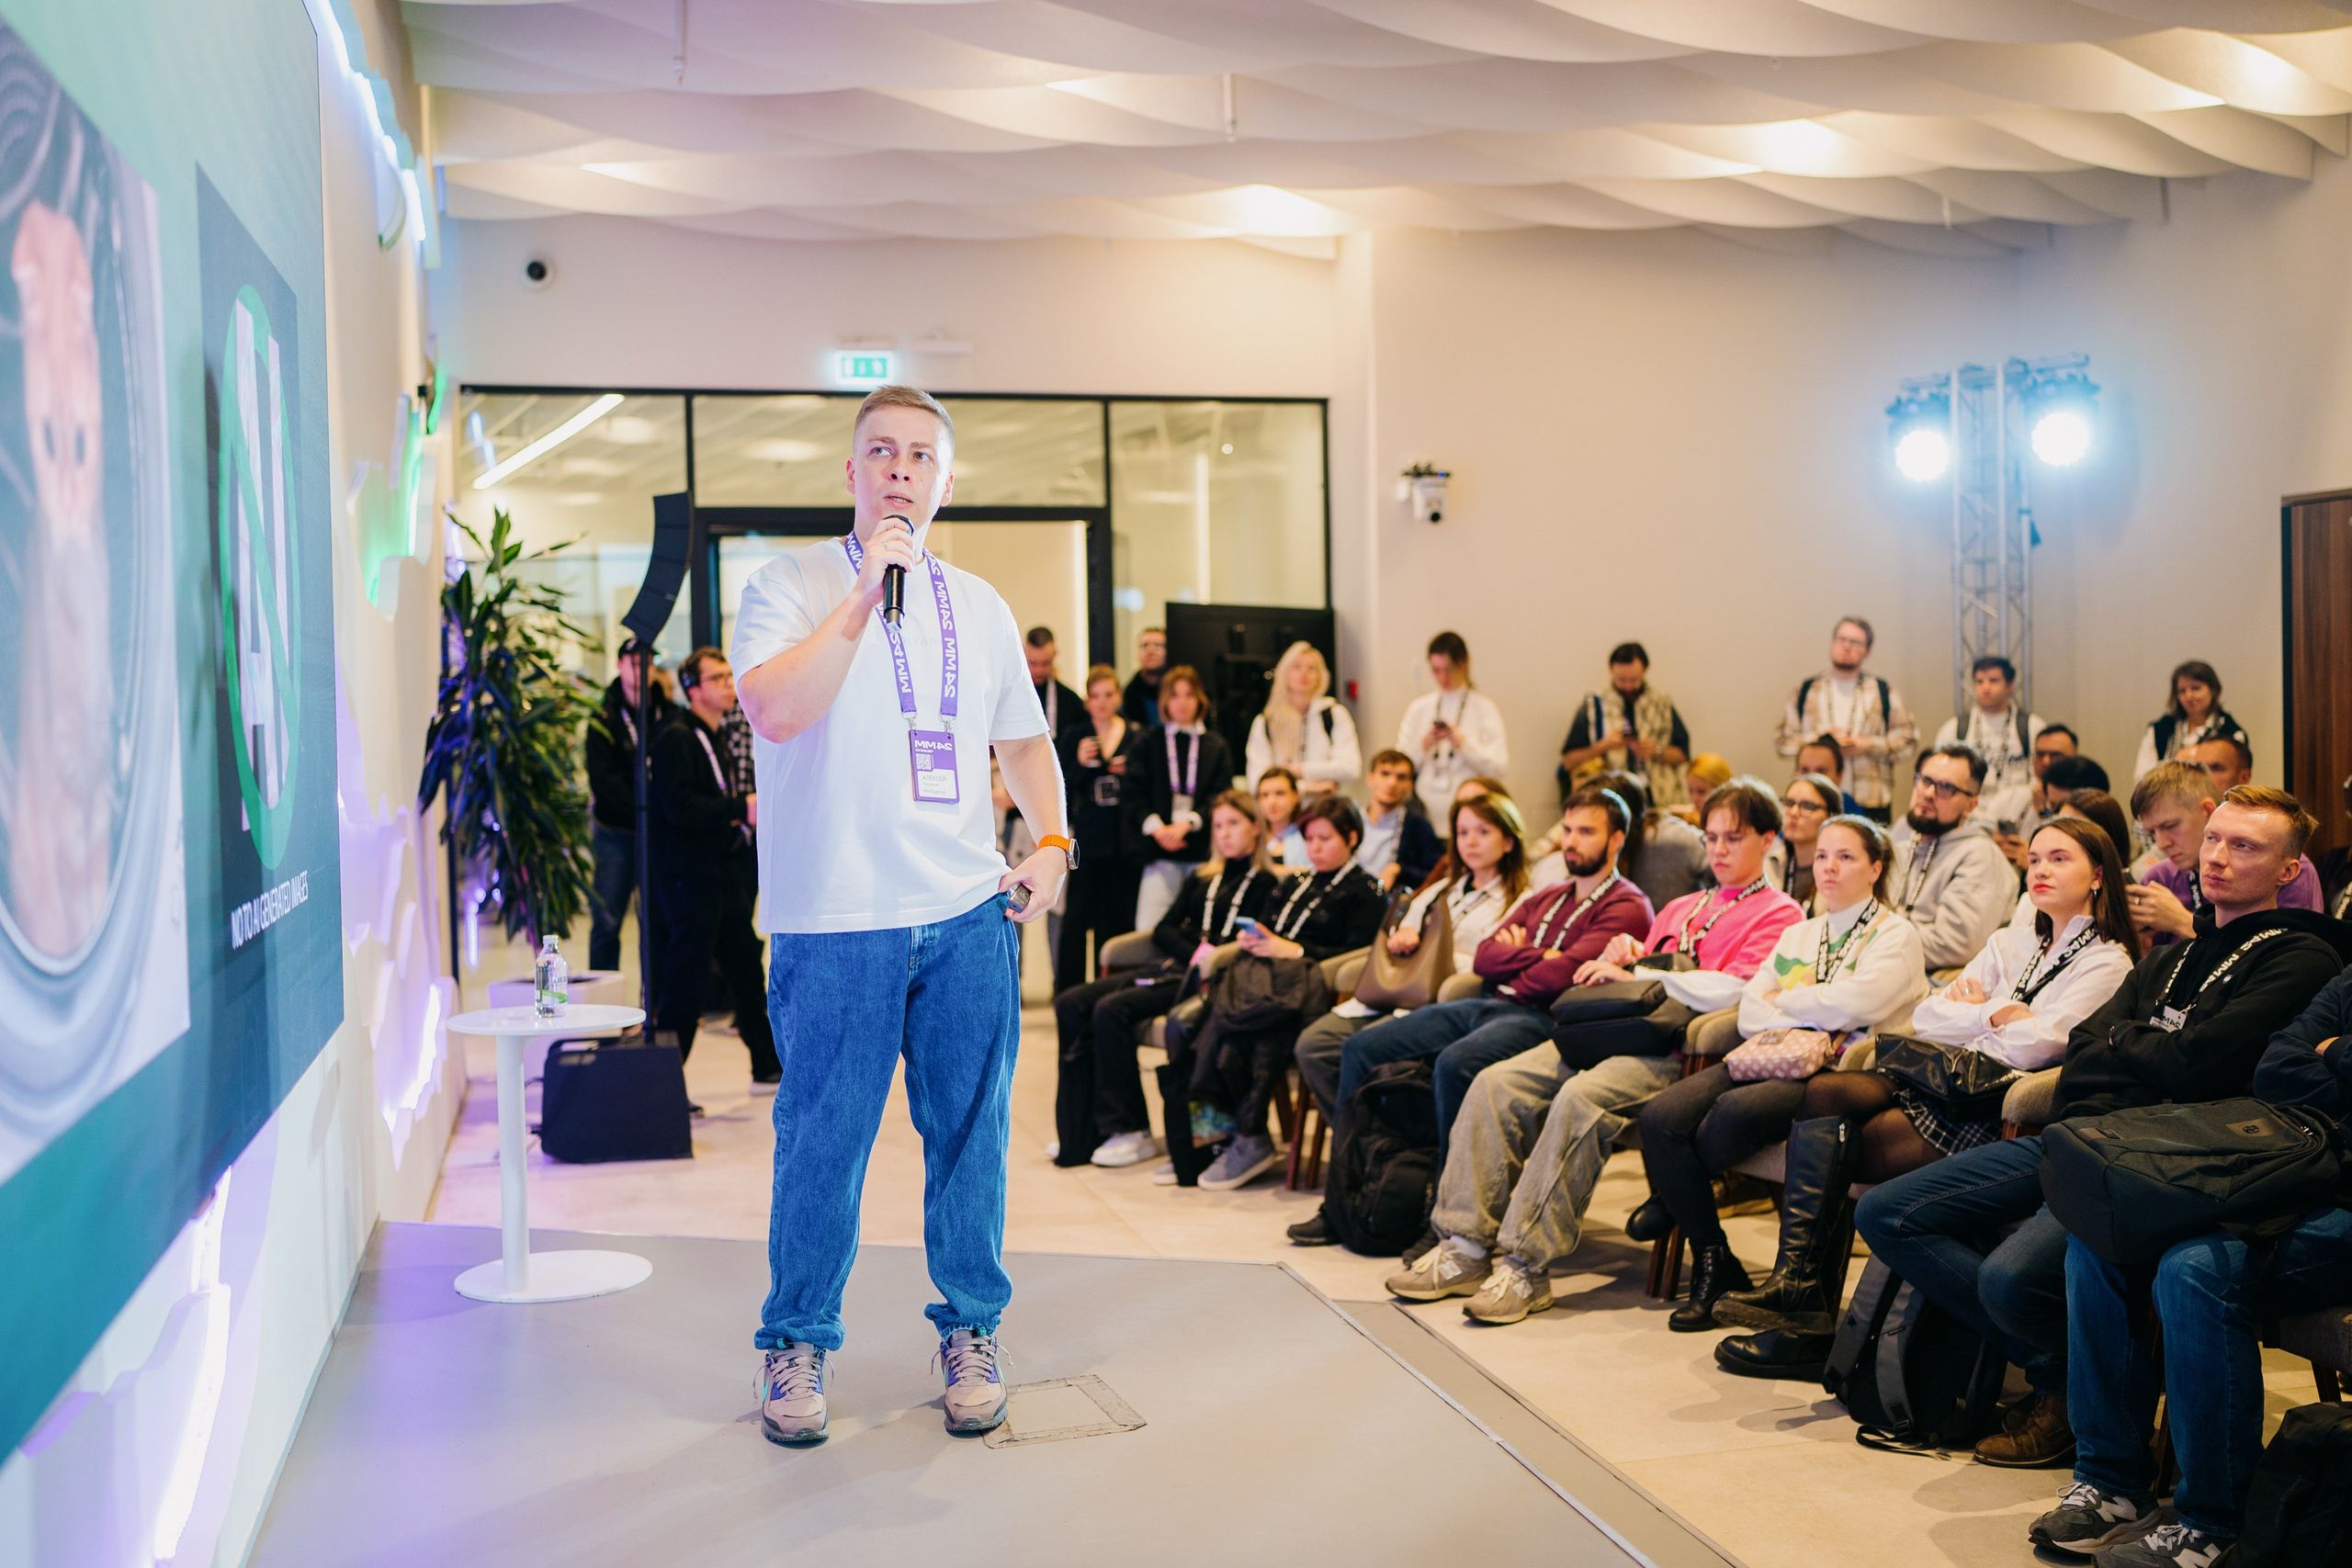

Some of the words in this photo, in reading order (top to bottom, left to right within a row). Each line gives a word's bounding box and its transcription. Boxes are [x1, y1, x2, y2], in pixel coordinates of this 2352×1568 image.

[231, 906, 244, 950] NO
[242, 900, 254, 942] TO
[259, 880, 291, 931] GENERATED
[290, 870, 309, 909] IMAGES
